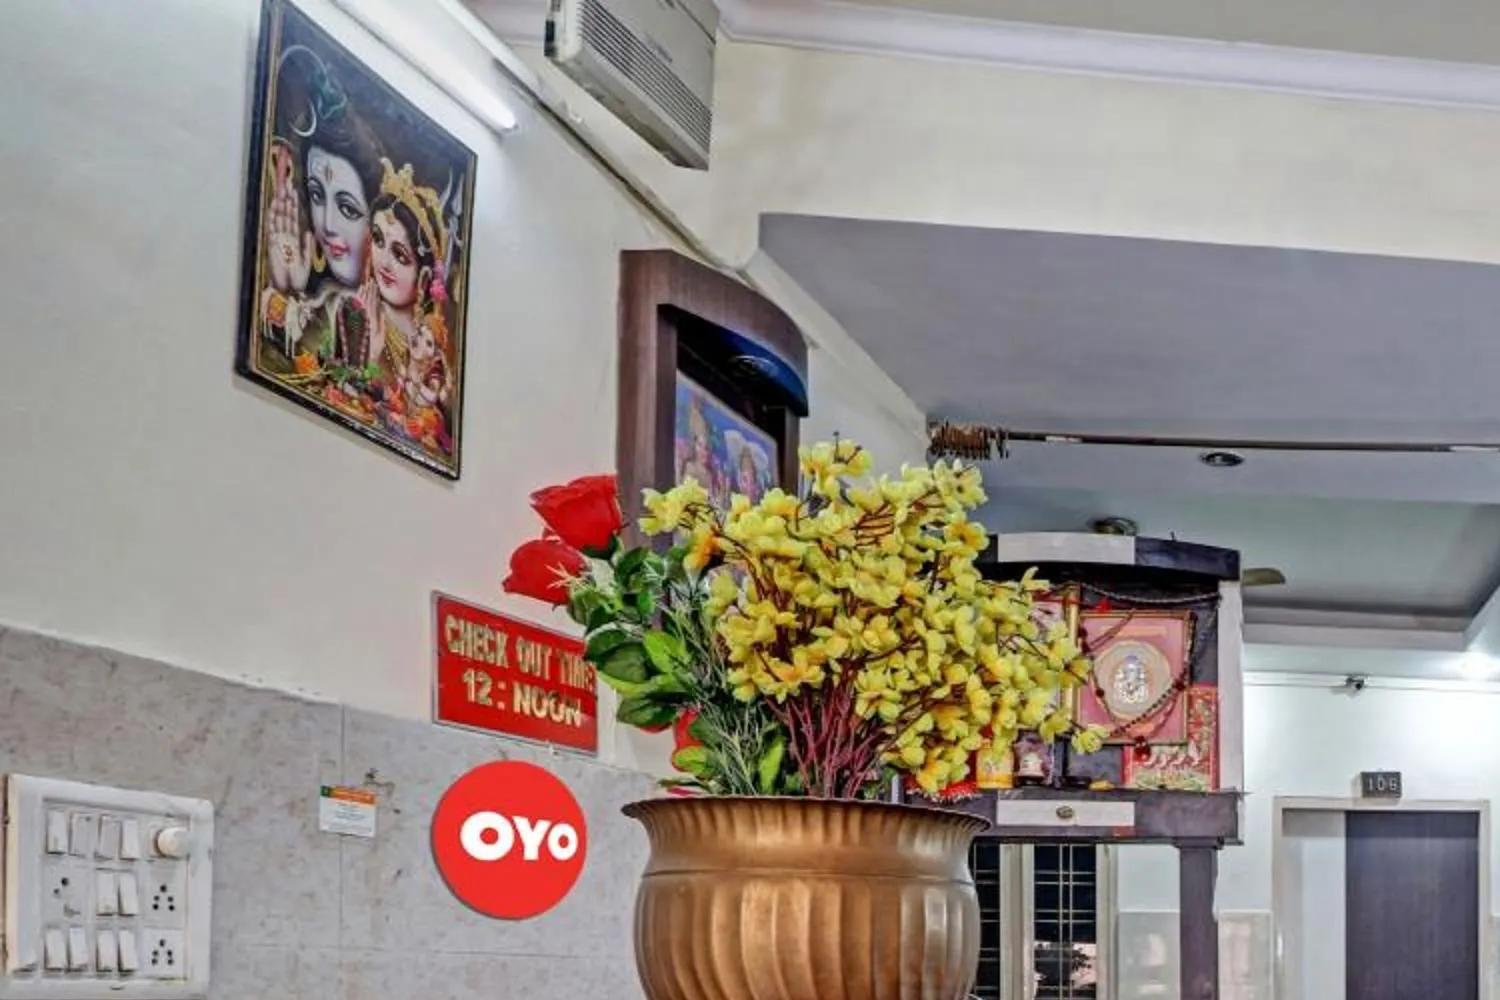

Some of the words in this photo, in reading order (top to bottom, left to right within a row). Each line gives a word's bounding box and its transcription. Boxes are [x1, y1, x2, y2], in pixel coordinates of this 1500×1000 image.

[445, 614, 509, 669] CHECK
[515, 636, 552, 683] OUT
[512, 682, 582, 727] NOON
[460, 811, 578, 861] OYO
